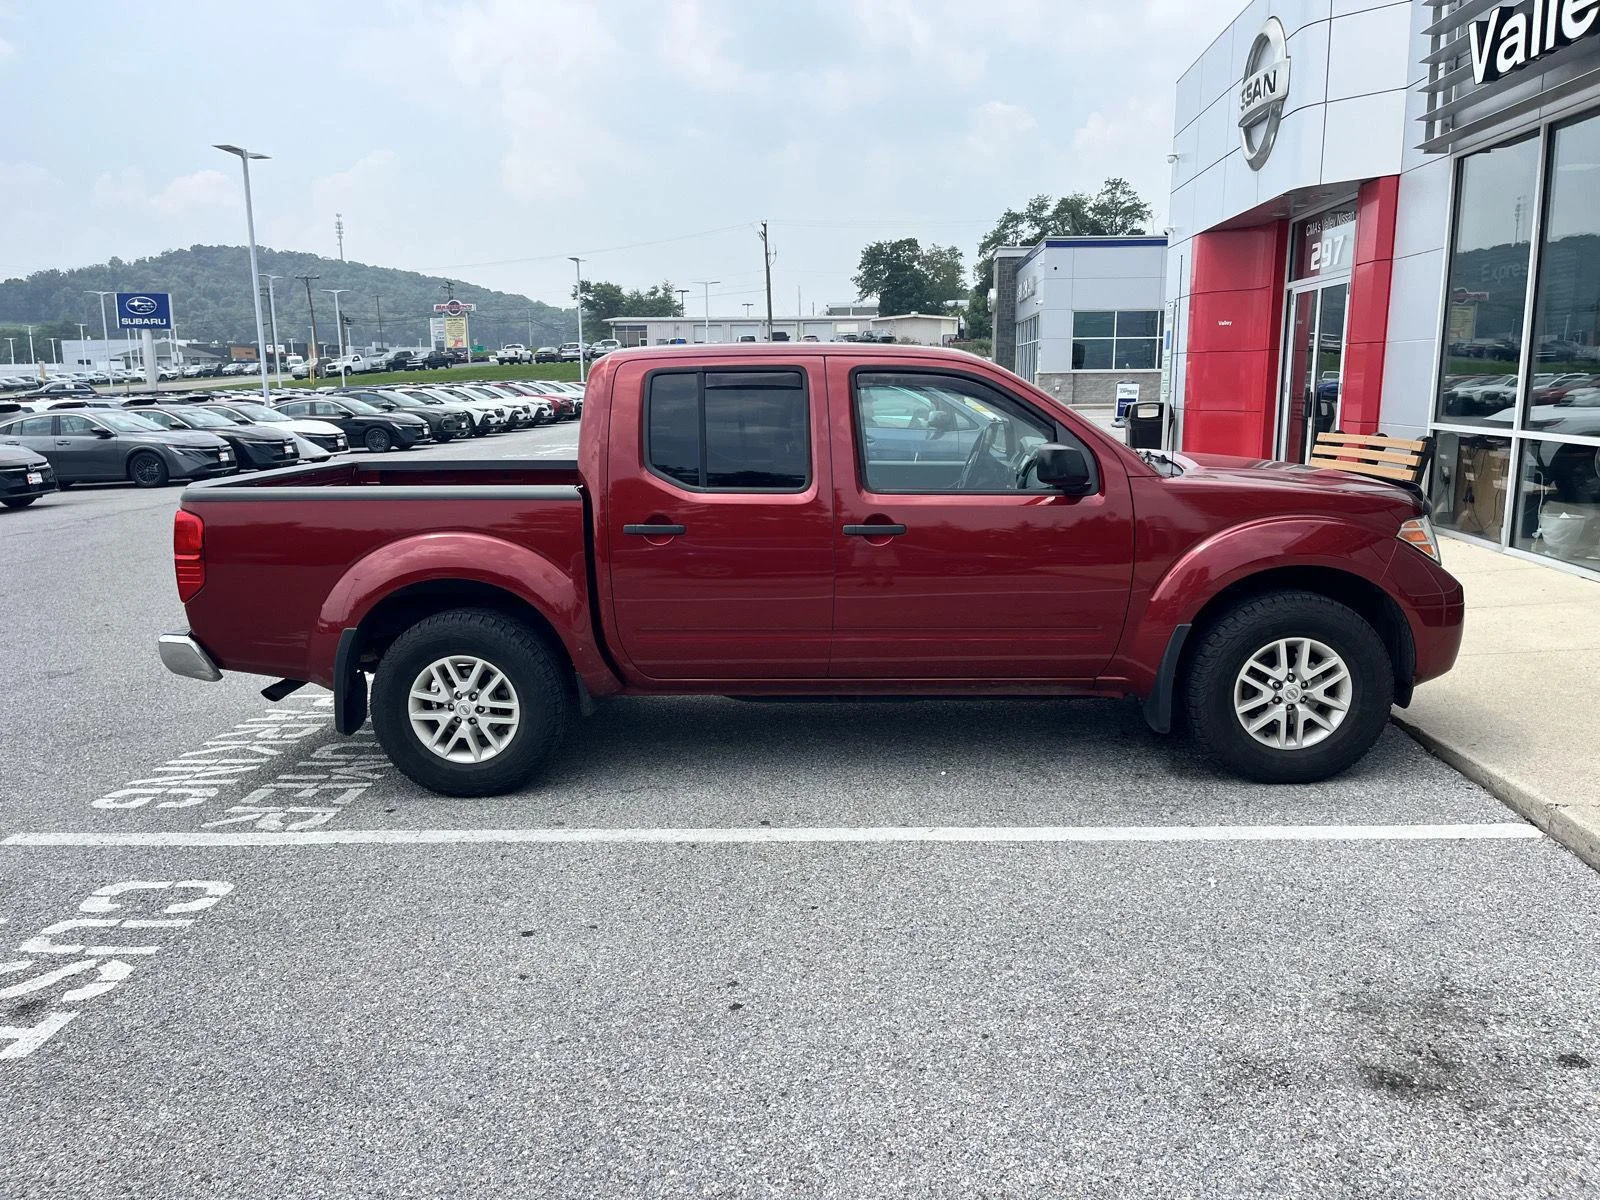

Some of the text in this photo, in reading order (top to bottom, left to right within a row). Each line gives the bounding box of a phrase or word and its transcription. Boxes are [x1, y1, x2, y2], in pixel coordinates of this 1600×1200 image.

[1468, 0, 1600, 85] Valle
[1337, 210, 1355, 227] Nissan
[1310, 235, 1344, 271] 297
[121, 317, 167, 325] SUBARU
